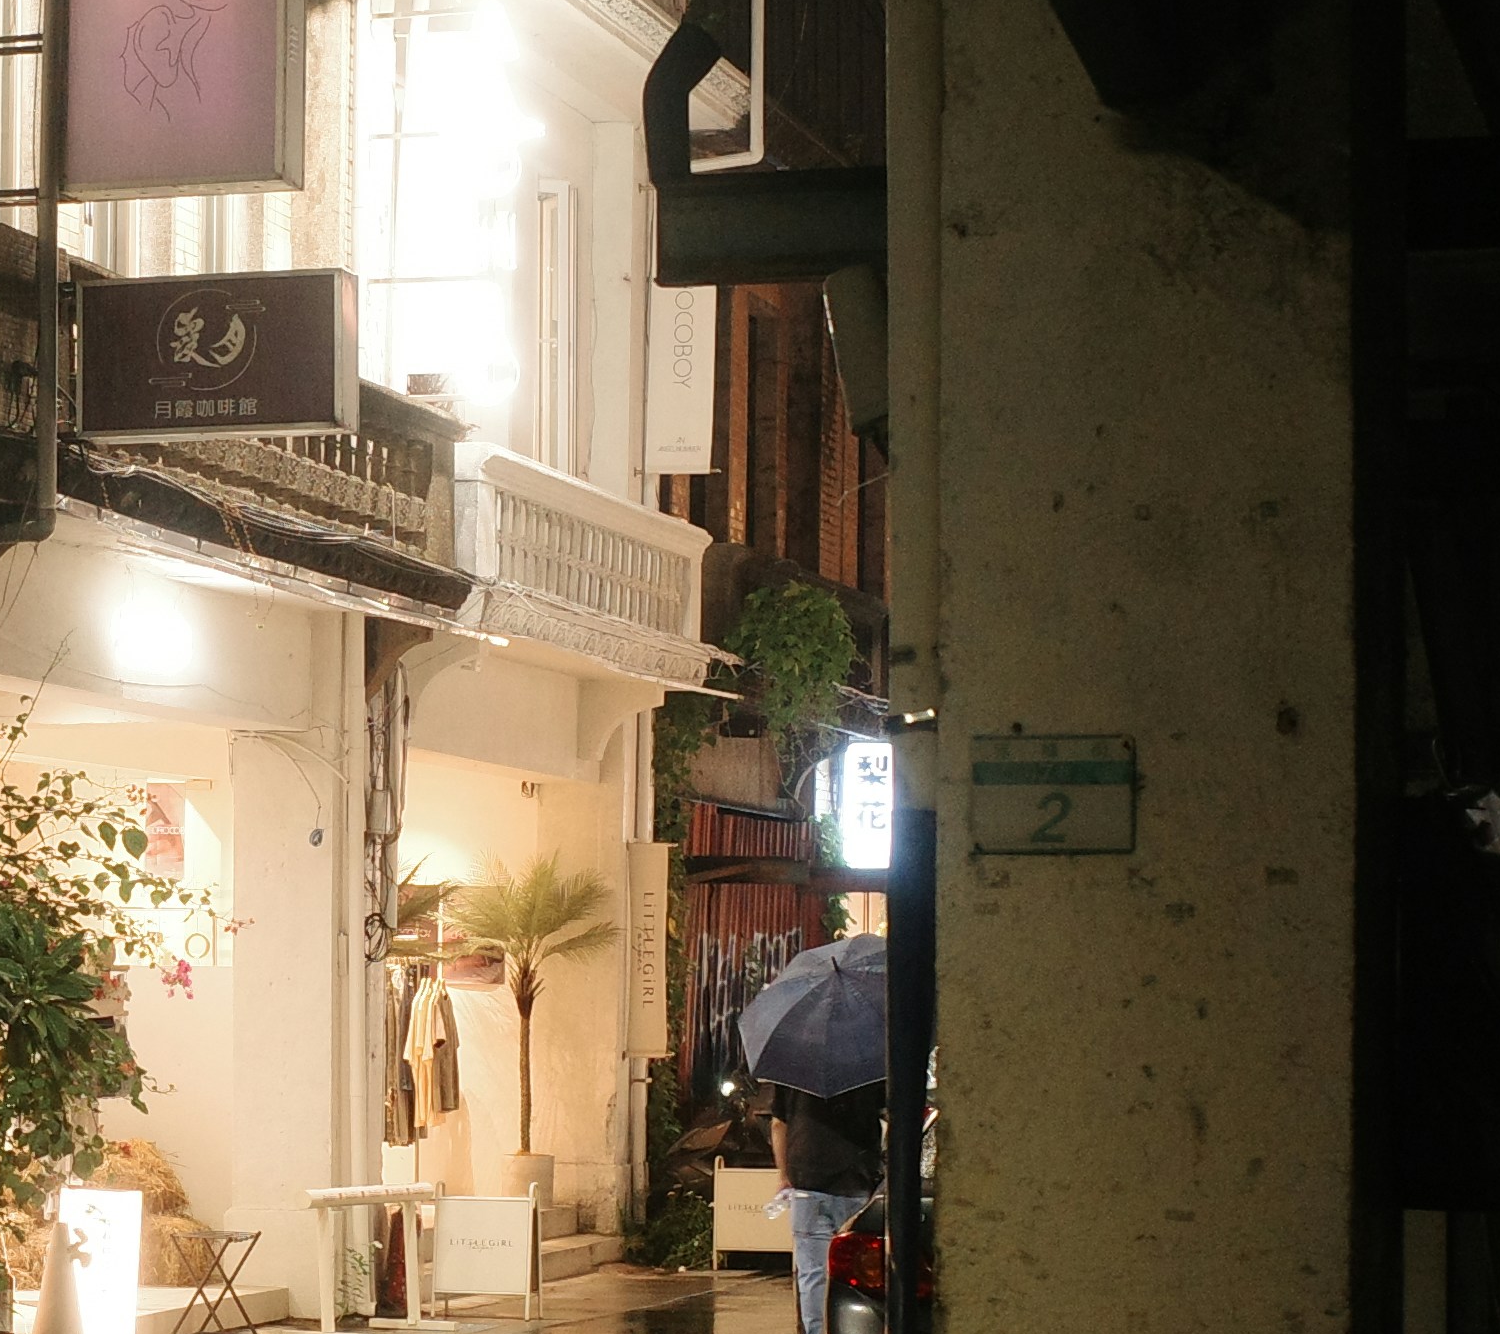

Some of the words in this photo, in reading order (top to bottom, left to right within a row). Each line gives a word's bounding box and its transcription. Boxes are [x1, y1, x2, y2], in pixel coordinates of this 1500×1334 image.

[672, 286, 696, 390] OCOBOY
[154, 397, 259, 420] 月霞咖啡館
[856, 755, 890, 831] 梨花
[1031, 791, 1073, 844] 2
